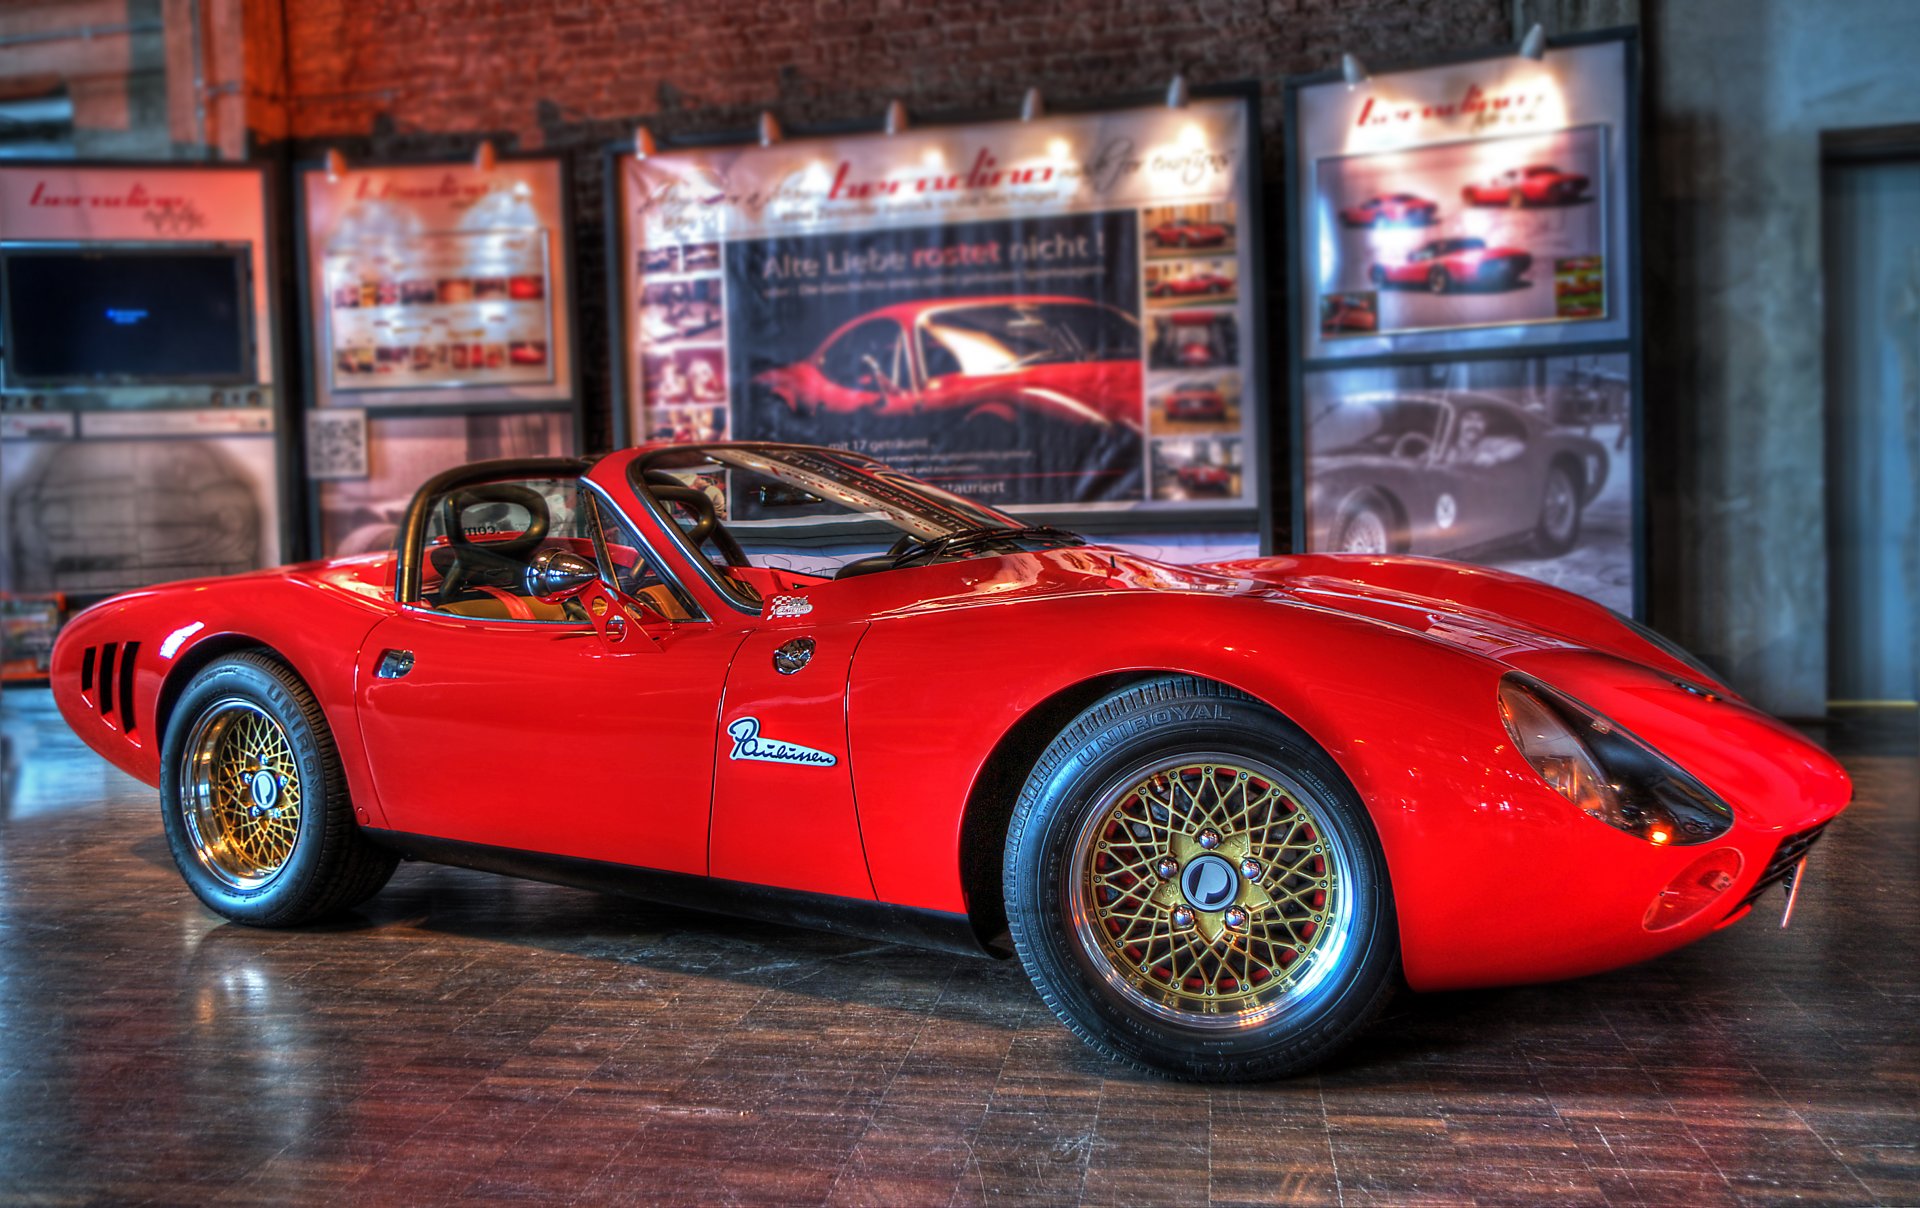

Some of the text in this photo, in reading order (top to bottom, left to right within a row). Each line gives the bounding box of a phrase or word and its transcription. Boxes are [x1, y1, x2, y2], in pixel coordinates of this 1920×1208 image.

[763, 253, 820, 280] Alte
[827, 248, 906, 276] Liebe
[912, 239, 1001, 270] rostet
[1010, 232, 1088, 262] nicht
[829, 441, 849, 451] mit
[853, 440, 867, 450] 17
[266, 683, 322, 839] UNIROYAL
[1076, 703, 1232, 768] UNIROYAL
